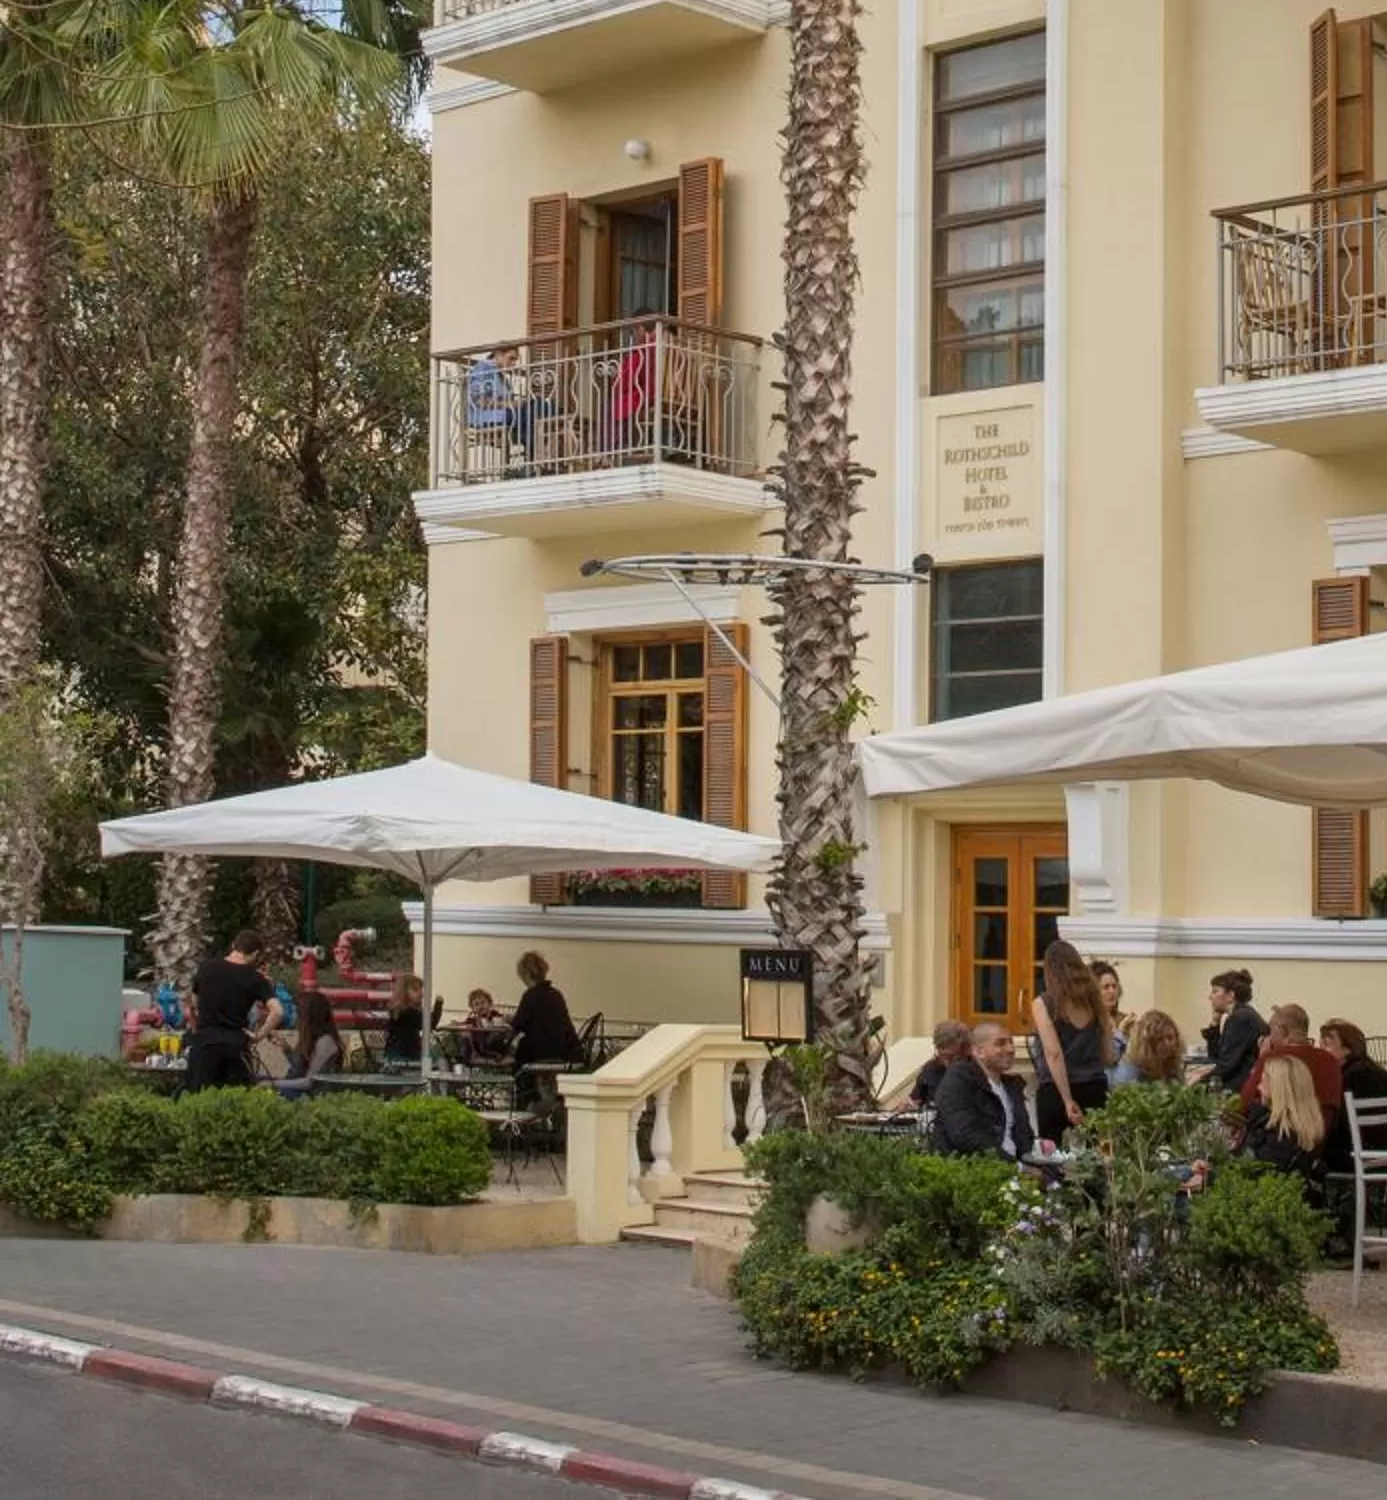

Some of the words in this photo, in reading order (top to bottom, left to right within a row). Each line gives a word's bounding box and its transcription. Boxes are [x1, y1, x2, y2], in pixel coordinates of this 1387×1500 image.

[974, 423, 1000, 439] THE
[944, 441, 1030, 464] ROTHSCHILD
[965, 466, 1008, 484] HOTEL
[963, 493, 1011, 512] BISTRO
[749, 956, 799, 972] MENU
